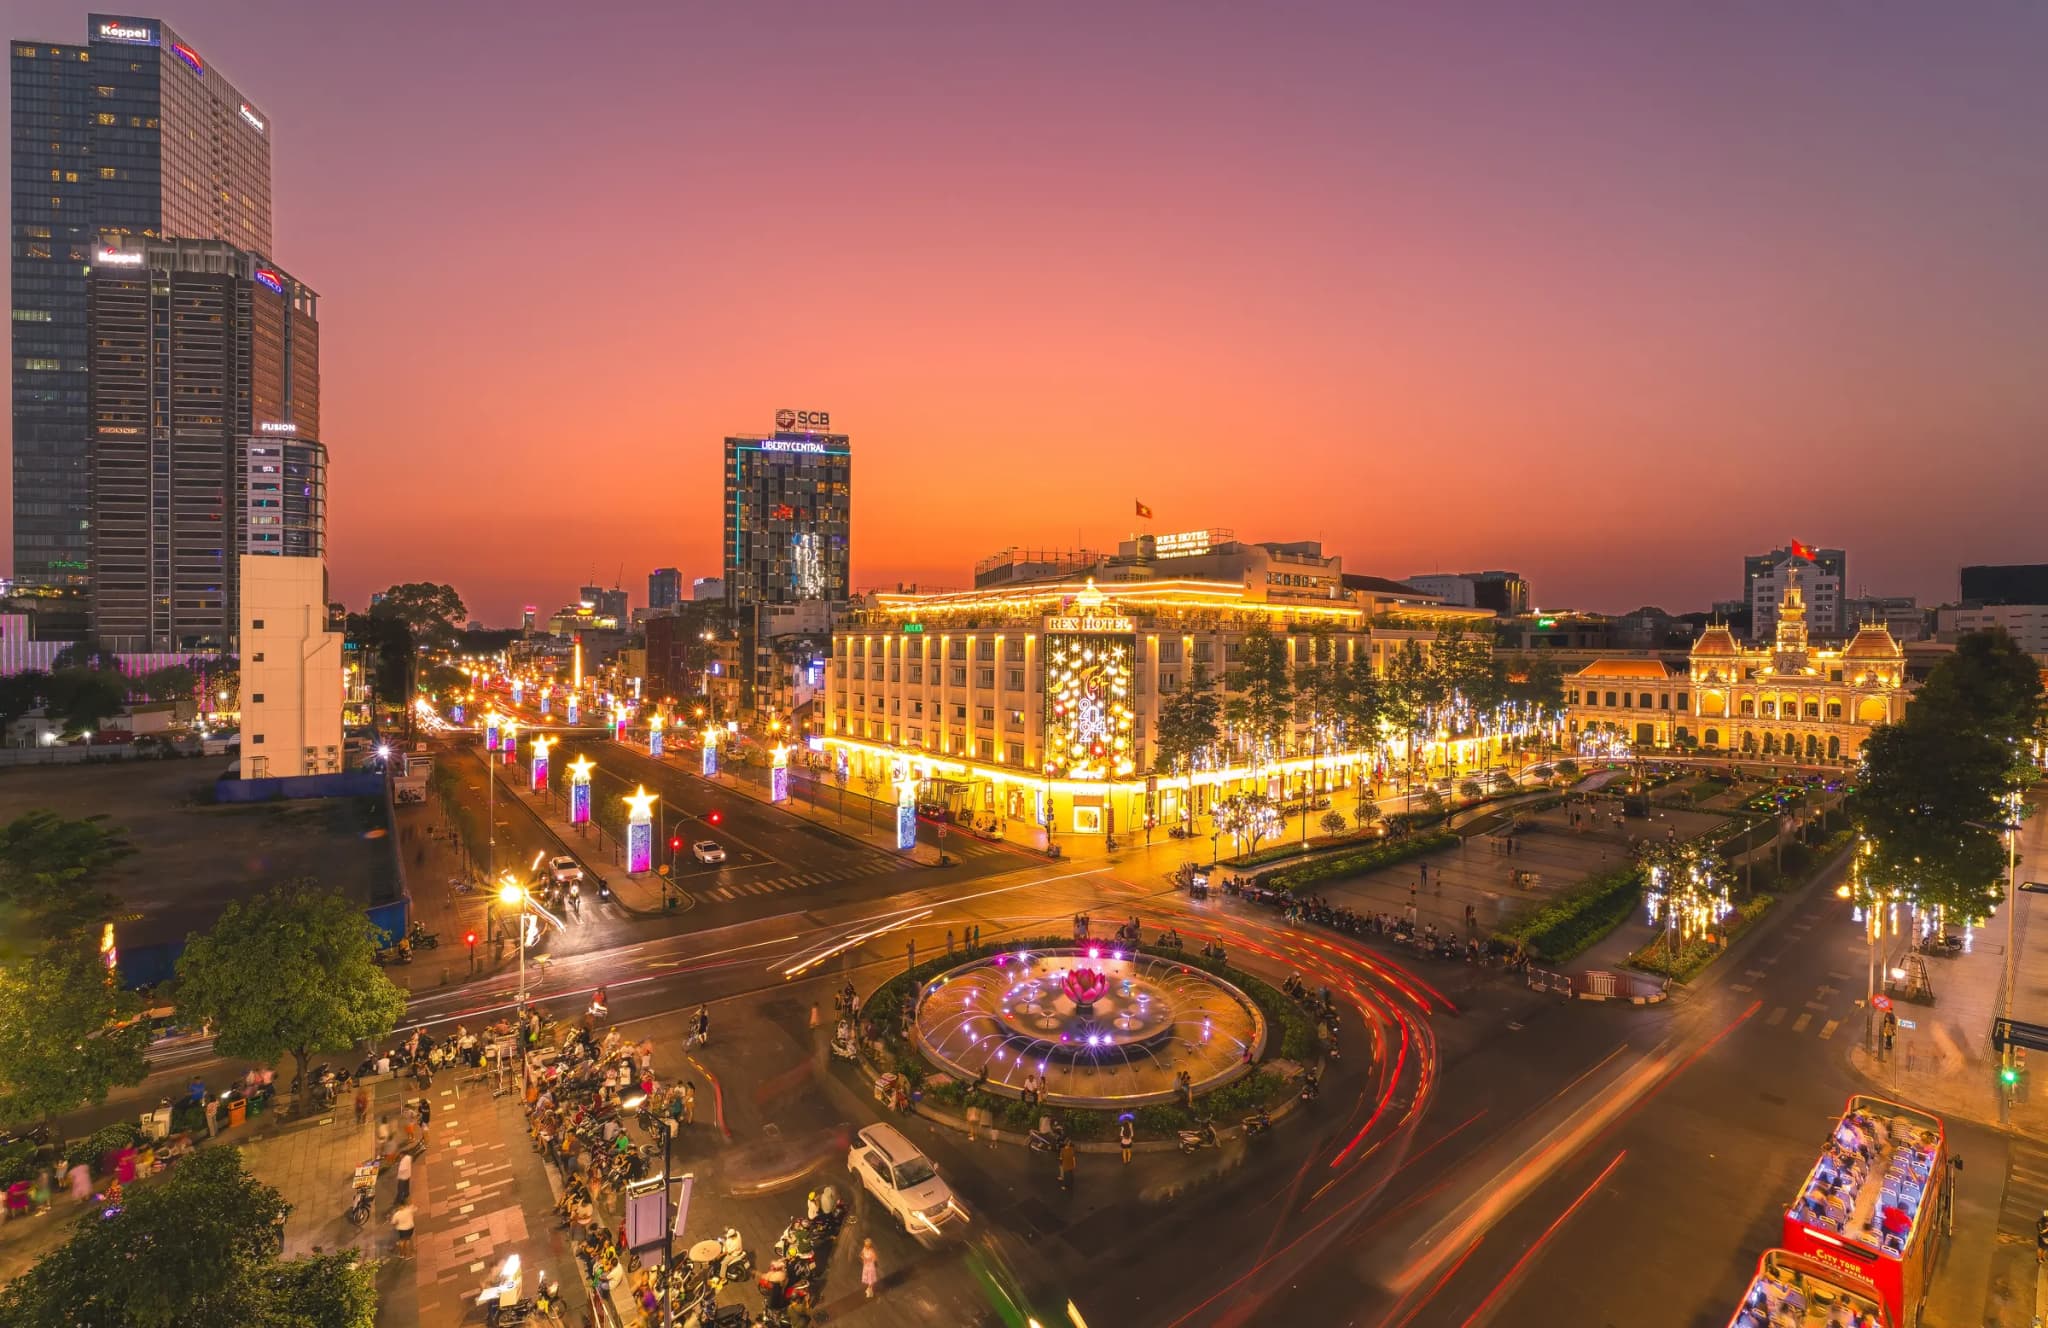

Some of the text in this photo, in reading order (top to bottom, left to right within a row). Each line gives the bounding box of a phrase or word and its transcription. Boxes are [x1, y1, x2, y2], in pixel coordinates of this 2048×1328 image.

[101, 25, 147, 39] Keppel
[797, 411, 829, 425] SCB
[261, 423, 296, 432] FUSION
[761, 441, 826, 453] LIBERTY CENTRAL
[1156, 530, 1209, 545] REX HOTEL
[1050, 617, 1133, 631] REX HOTEL
[1839, 1259, 1862, 1274] TOUR
